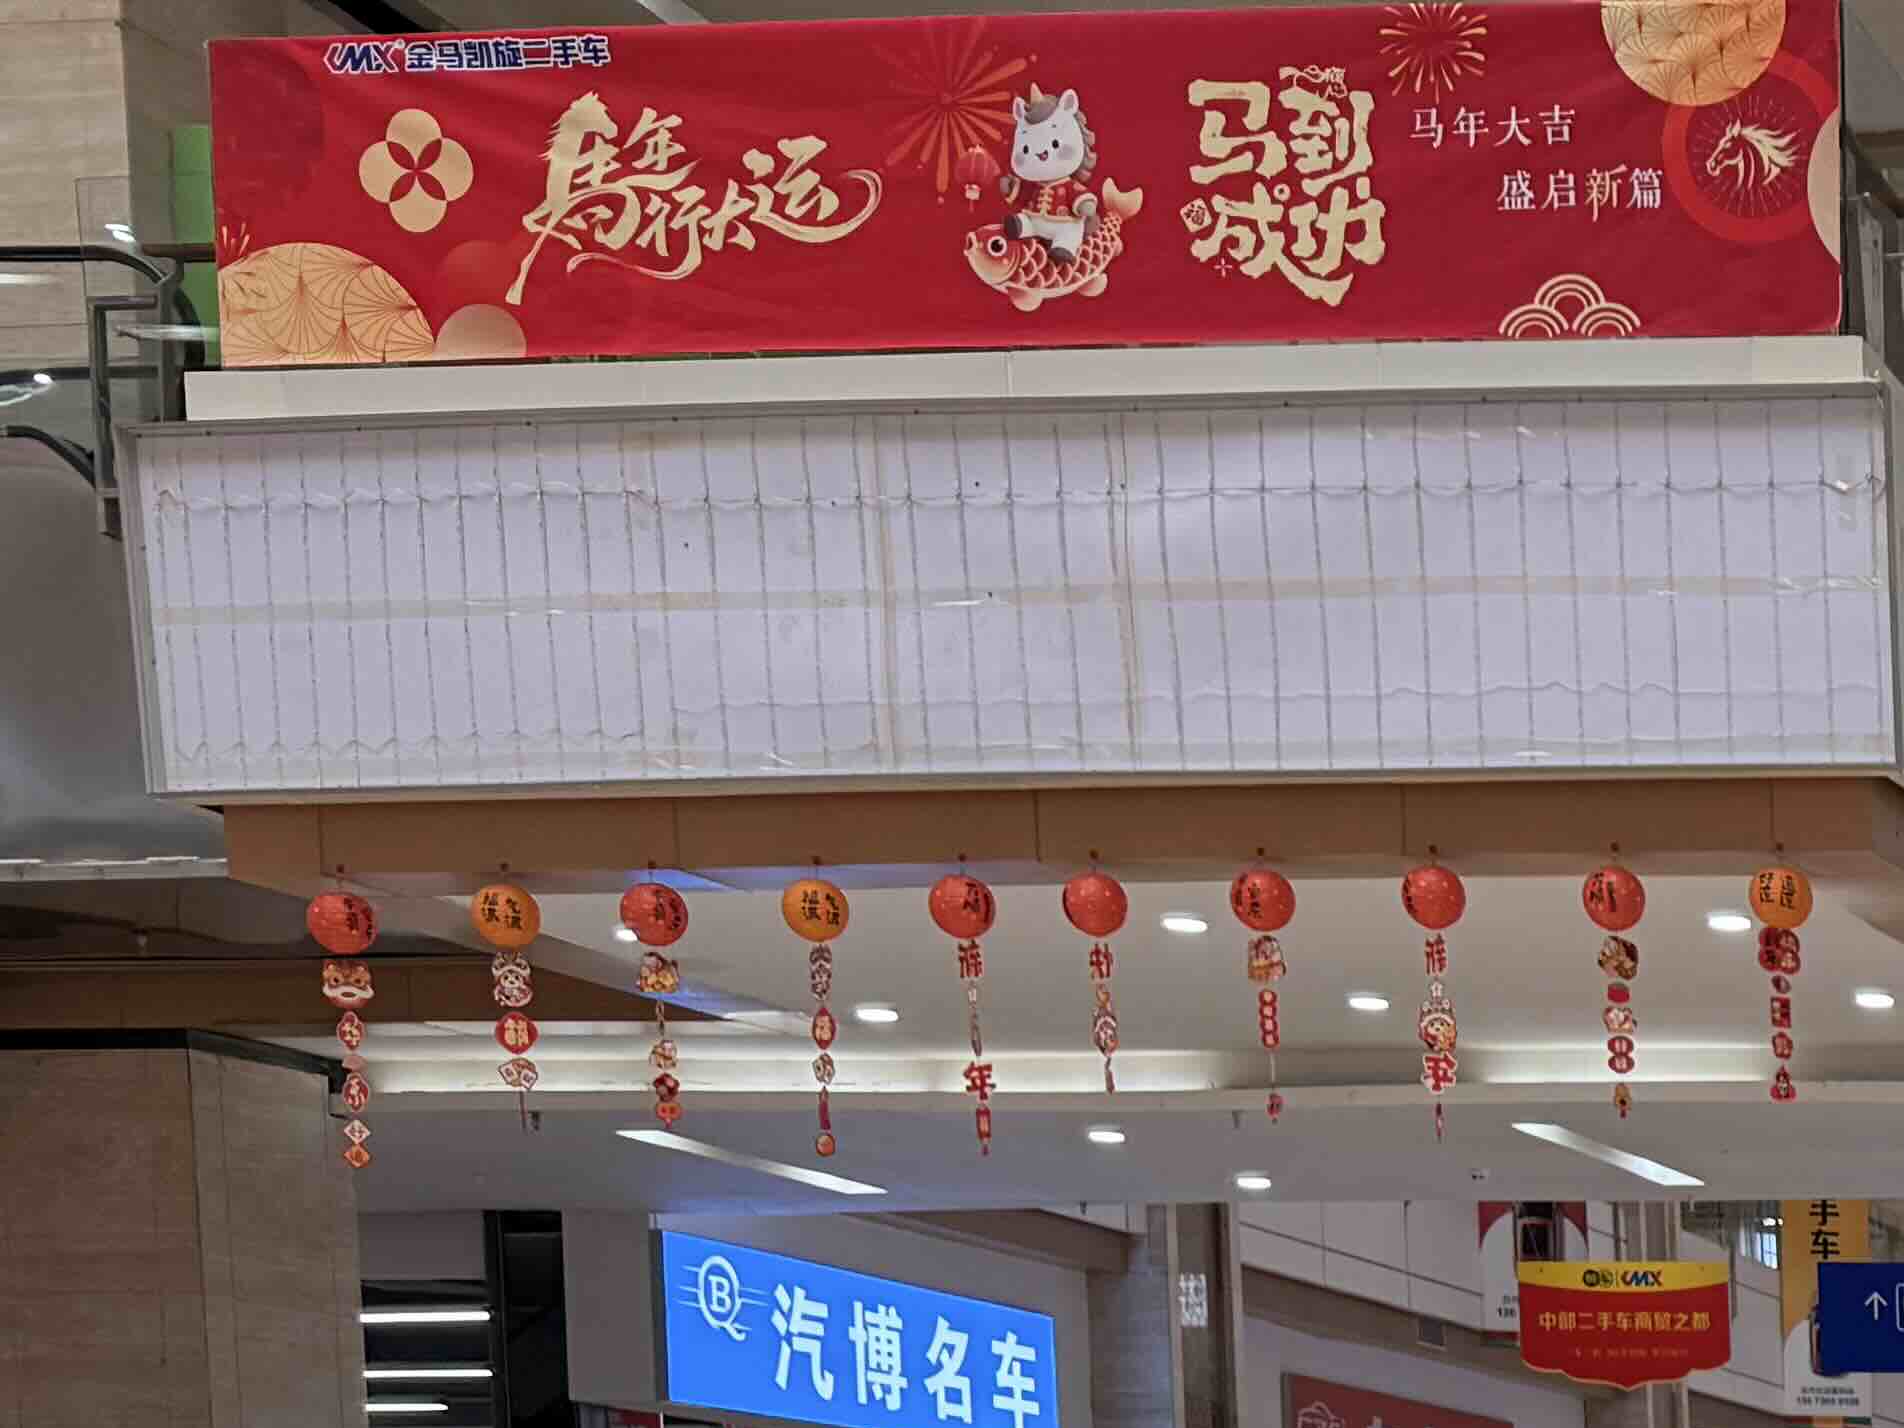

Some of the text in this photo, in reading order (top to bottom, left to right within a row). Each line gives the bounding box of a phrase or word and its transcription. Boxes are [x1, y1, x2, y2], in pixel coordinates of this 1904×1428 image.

[405, 36, 611, 72] 金马凯旋二手车
[1409, 105, 1576, 149] 马年大吉
[1497, 164, 1662, 220] 盛启新篇
